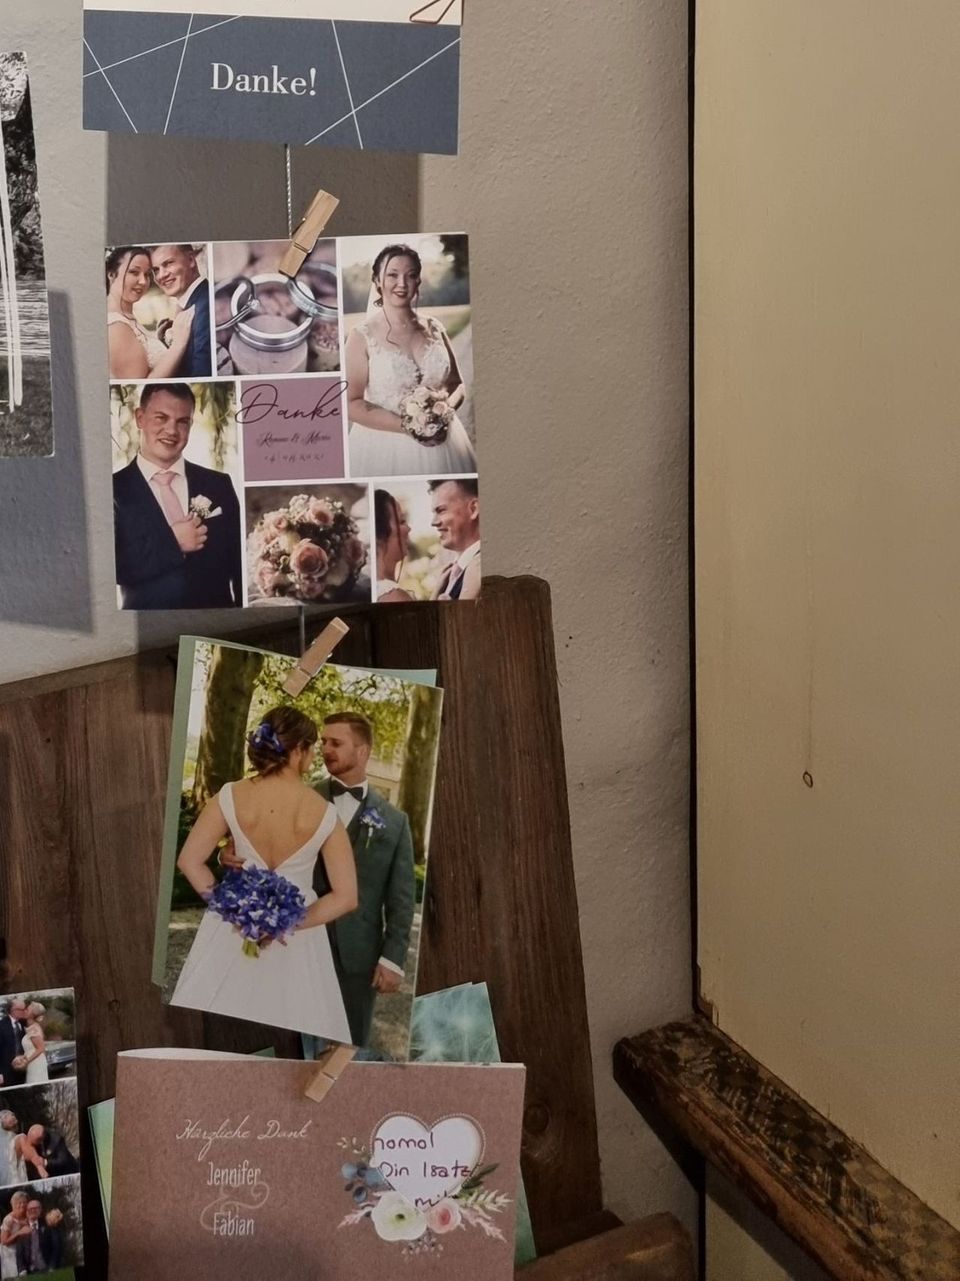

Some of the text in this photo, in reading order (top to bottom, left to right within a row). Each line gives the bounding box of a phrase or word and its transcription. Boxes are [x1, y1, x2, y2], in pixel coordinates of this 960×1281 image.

[210, 63, 317, 96] Danke!
[235, 380, 349, 424] Danke
[206, 1159, 262, 1189] Jennifer
[213, 1210, 255, 1236] Fabian
